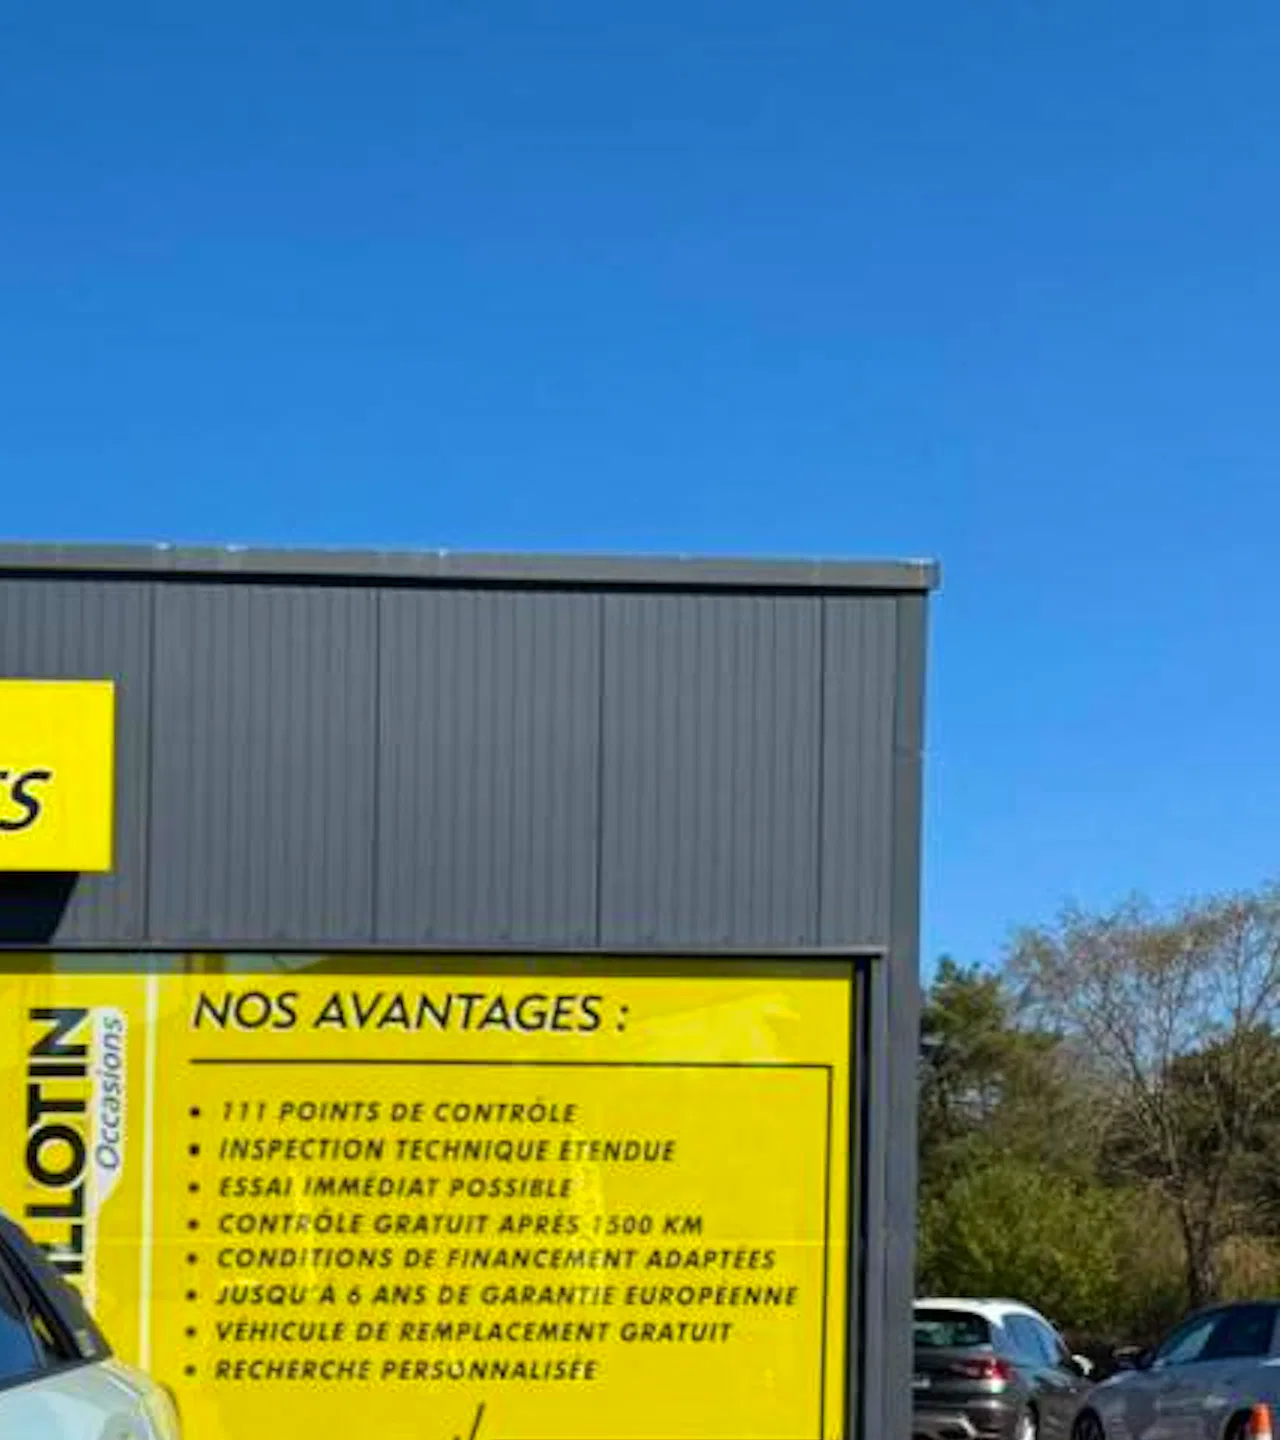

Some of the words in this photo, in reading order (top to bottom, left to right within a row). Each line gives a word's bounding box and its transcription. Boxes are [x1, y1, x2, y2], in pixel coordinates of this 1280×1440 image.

[194, 990, 298, 1029] NOS
[312, 992, 603, 1032] AVANTAGES
[94, 1015, 124, 1171] Occasions
[223, 1101, 267, 1121] 111
[278, 1100, 381, 1123] POINTS
[390, 1101, 425, 1123] DE
[433, 1096, 577, 1124] CONTRÔLE
[218, 1137, 386, 1162] INSPECTION
[396, 1138, 550, 1164] TECHNIQUE
[558, 1134, 676, 1163] ÉTENDUE
[218, 1176, 293, 1198] ESSAI
[303, 1170, 440, 1198] IMMÉDIAT
[448, 1176, 572, 1199] POSSIBLE
[218, 1207, 364, 1235] CONTRÔLE
[373, 1212, 489, 1235] GRATUIT
[497, 1208, 579, 1236] APRÈS
[593, 1213, 654, 1237] 1500
[662, 1215, 703, 1236] KM
[216, 1247, 393, 1270] CONDITIONS
[403, 1247, 437, 1270] DE
[446, 1247, 638, 1270] FINANCEMENT
[346, 1285, 363, 1306] 6
[370, 1284, 427, 1306] ANS
[437, 1284, 471, 1306] DE
[479, 1284, 616, 1306] GARANTIE
[355, 1321, 389, 1342] DE
[398, 1321, 611, 1343] REMPLACEMENT
[619, 1321, 733, 1343] GRATUIT
[214, 1358, 372, 1381] RECHERCHE
